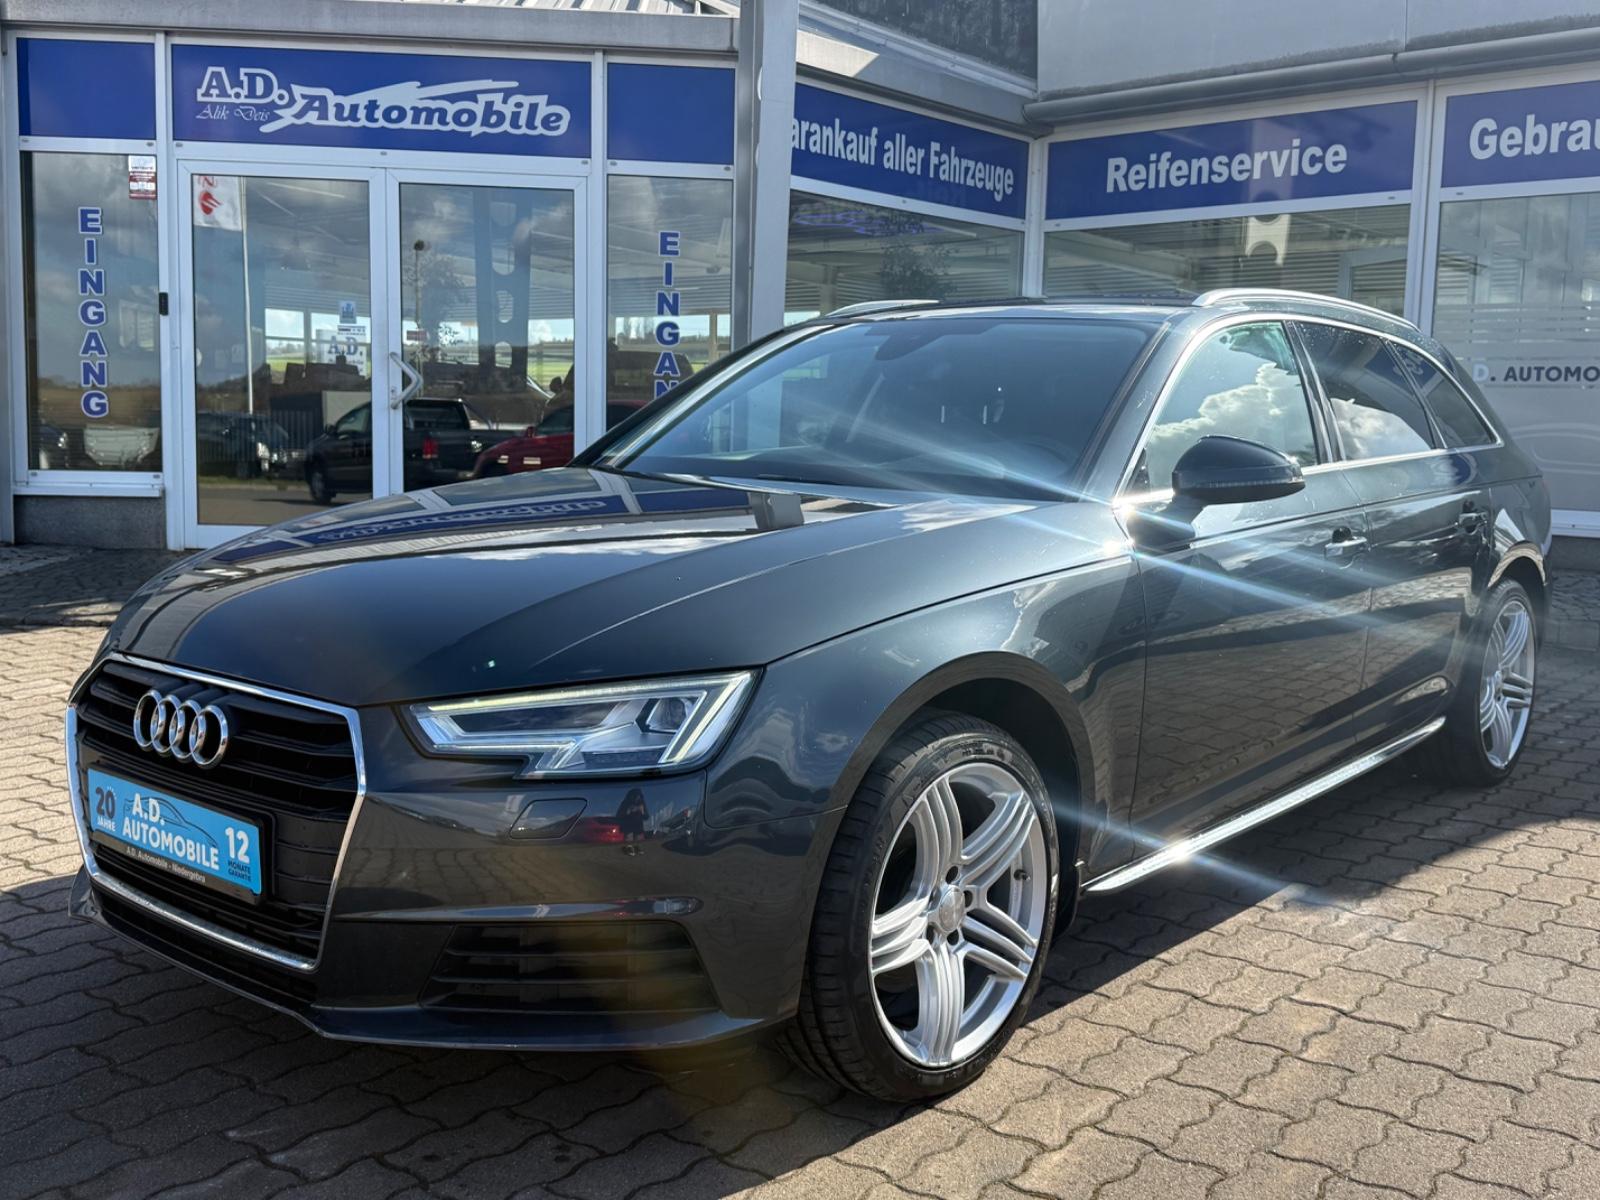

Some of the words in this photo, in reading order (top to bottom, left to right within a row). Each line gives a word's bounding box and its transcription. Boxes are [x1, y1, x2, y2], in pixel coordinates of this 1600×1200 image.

[195, 104, 230, 120] Alik
[197, 66, 289, 105] A.D.
[294, 86, 571, 136] Automobile
[883, 133, 925, 176] aller
[929, 141, 1014, 202] Fahrzeuge
[1106, 138, 1348, 193] Reifenservice
[78, 206, 109, 418] EINGANG
[1503, 366, 1600, 382] AUTOMO
[95, 786, 116, 819] 20
[132, 793, 165, 826] A.D.
[122, 816, 219, 870] AUTOMOBILE
[225, 827, 250, 864] 12
